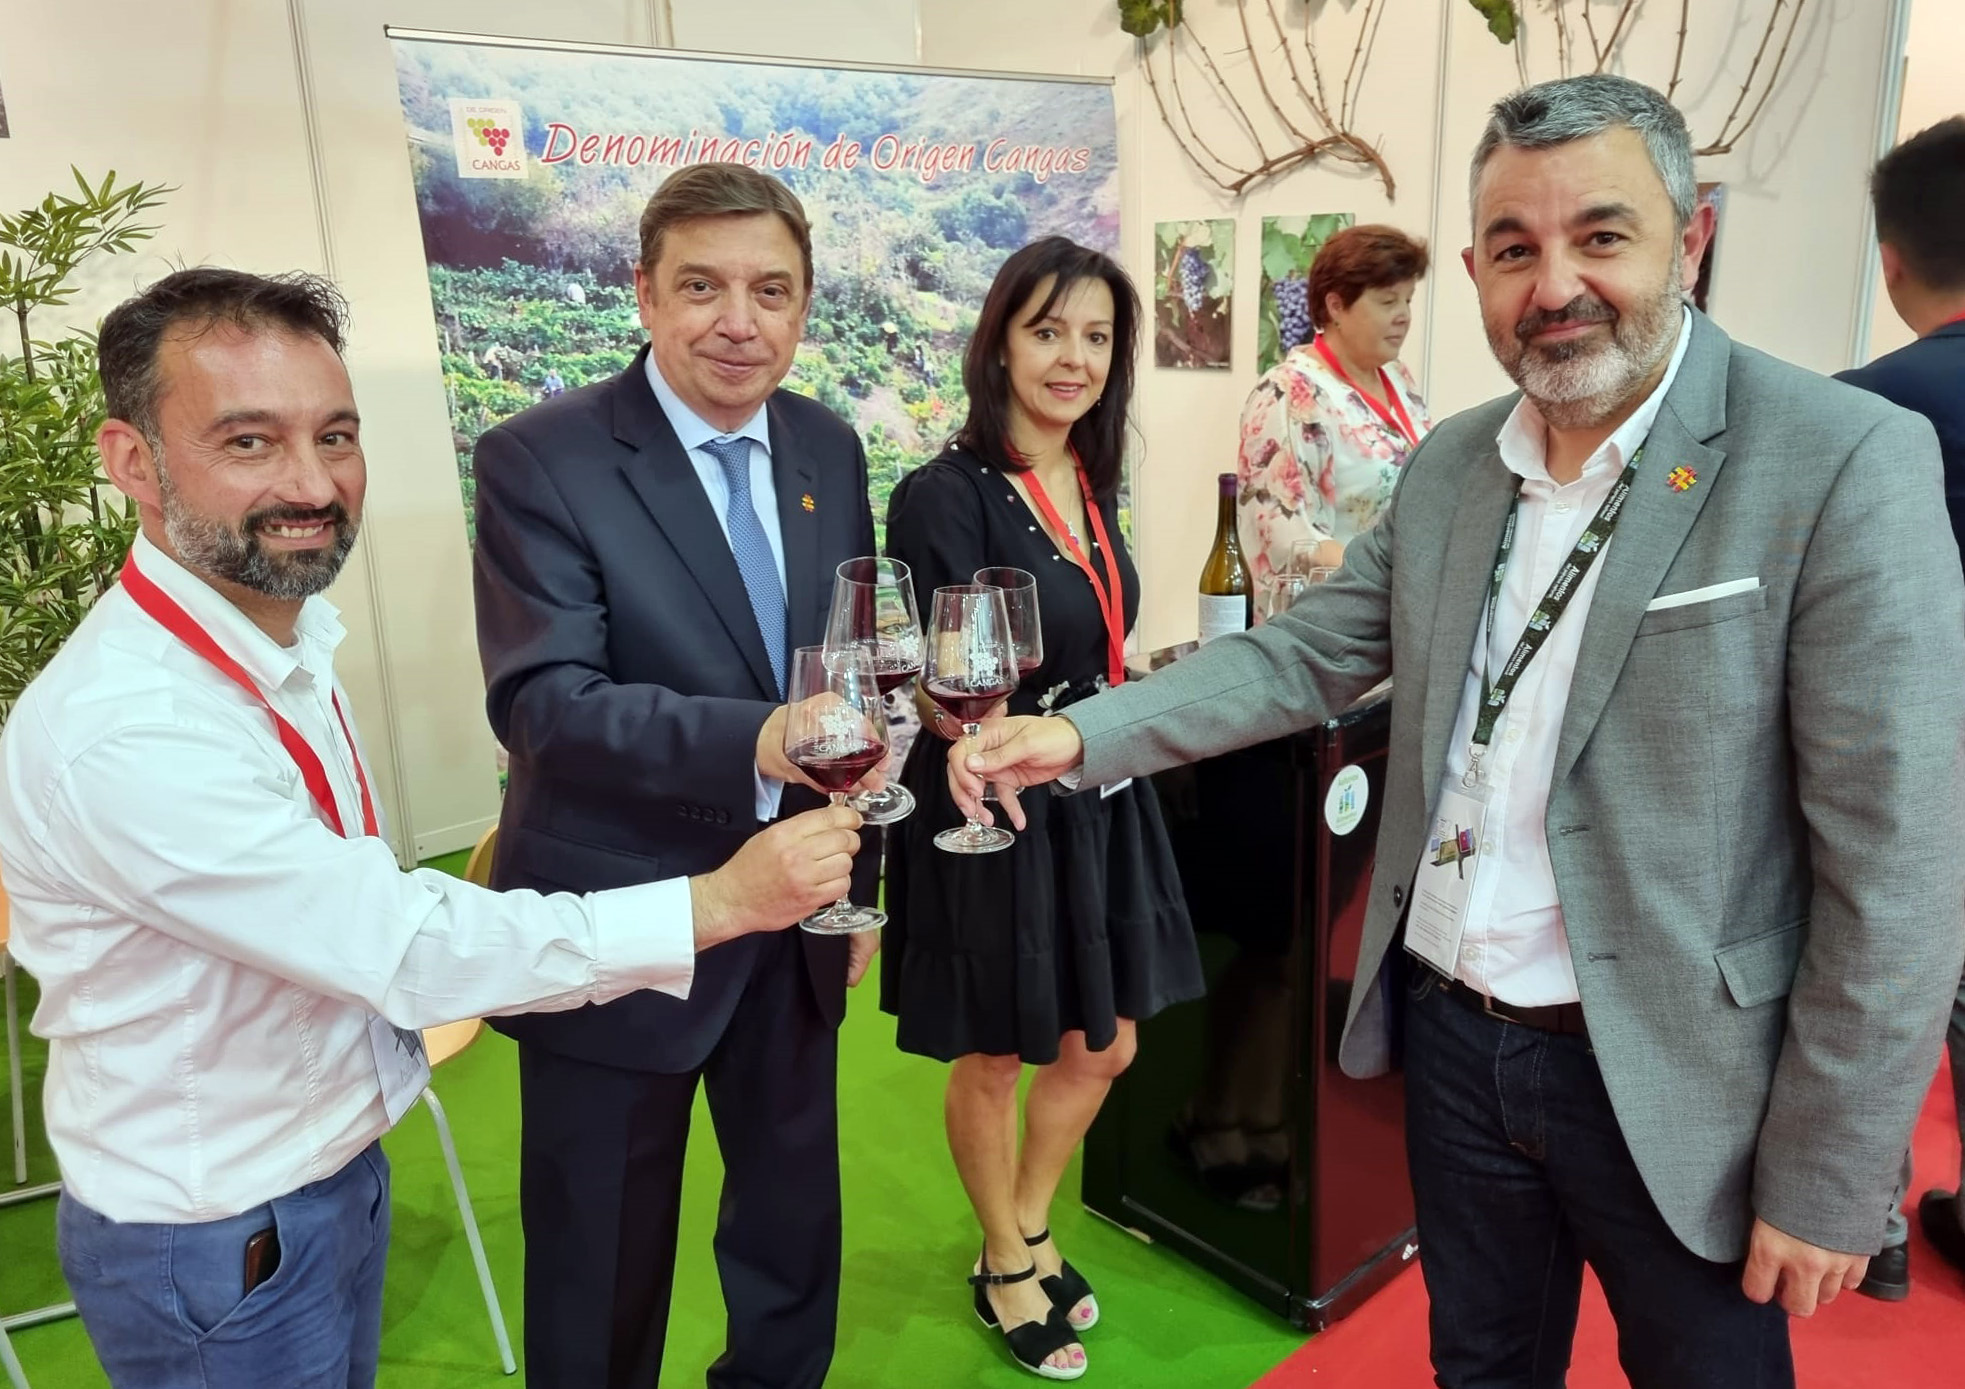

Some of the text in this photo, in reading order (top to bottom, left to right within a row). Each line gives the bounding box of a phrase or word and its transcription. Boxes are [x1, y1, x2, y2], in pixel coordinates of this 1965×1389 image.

[472, 159, 521, 171] CANGAS
[541, 123, 1090, 182] Denominación de Origen Cangas
[1604, 484, 1631, 522] Alimentos
[1553, 565, 1580, 601] Alimentos
[1508, 643, 1533, 677] Alimentos
